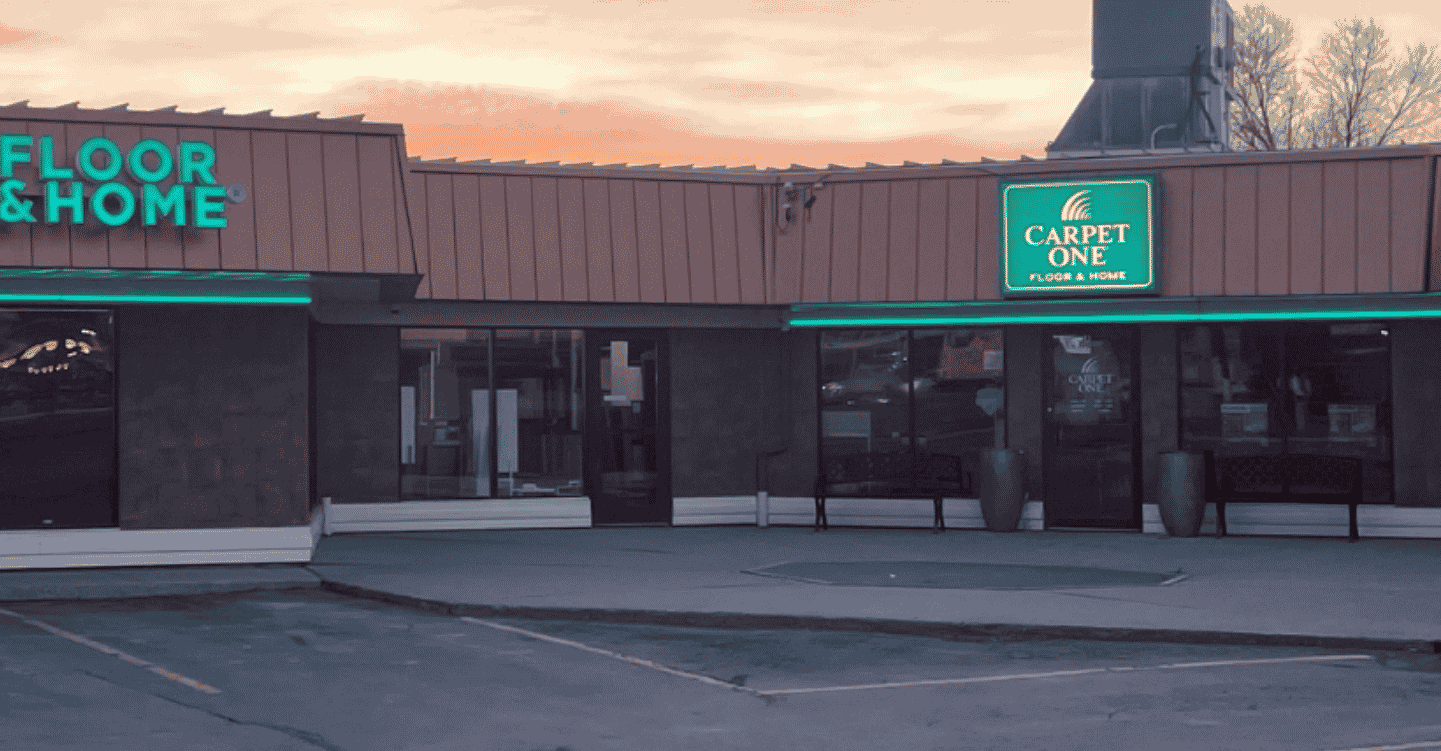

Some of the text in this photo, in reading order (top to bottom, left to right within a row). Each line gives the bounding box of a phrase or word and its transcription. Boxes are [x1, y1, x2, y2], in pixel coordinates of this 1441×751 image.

[1024, 223, 1130, 246] CARPET
[1047, 245, 1108, 268] ONE
[1029, 270, 1127, 282] FLOOR & HOME
